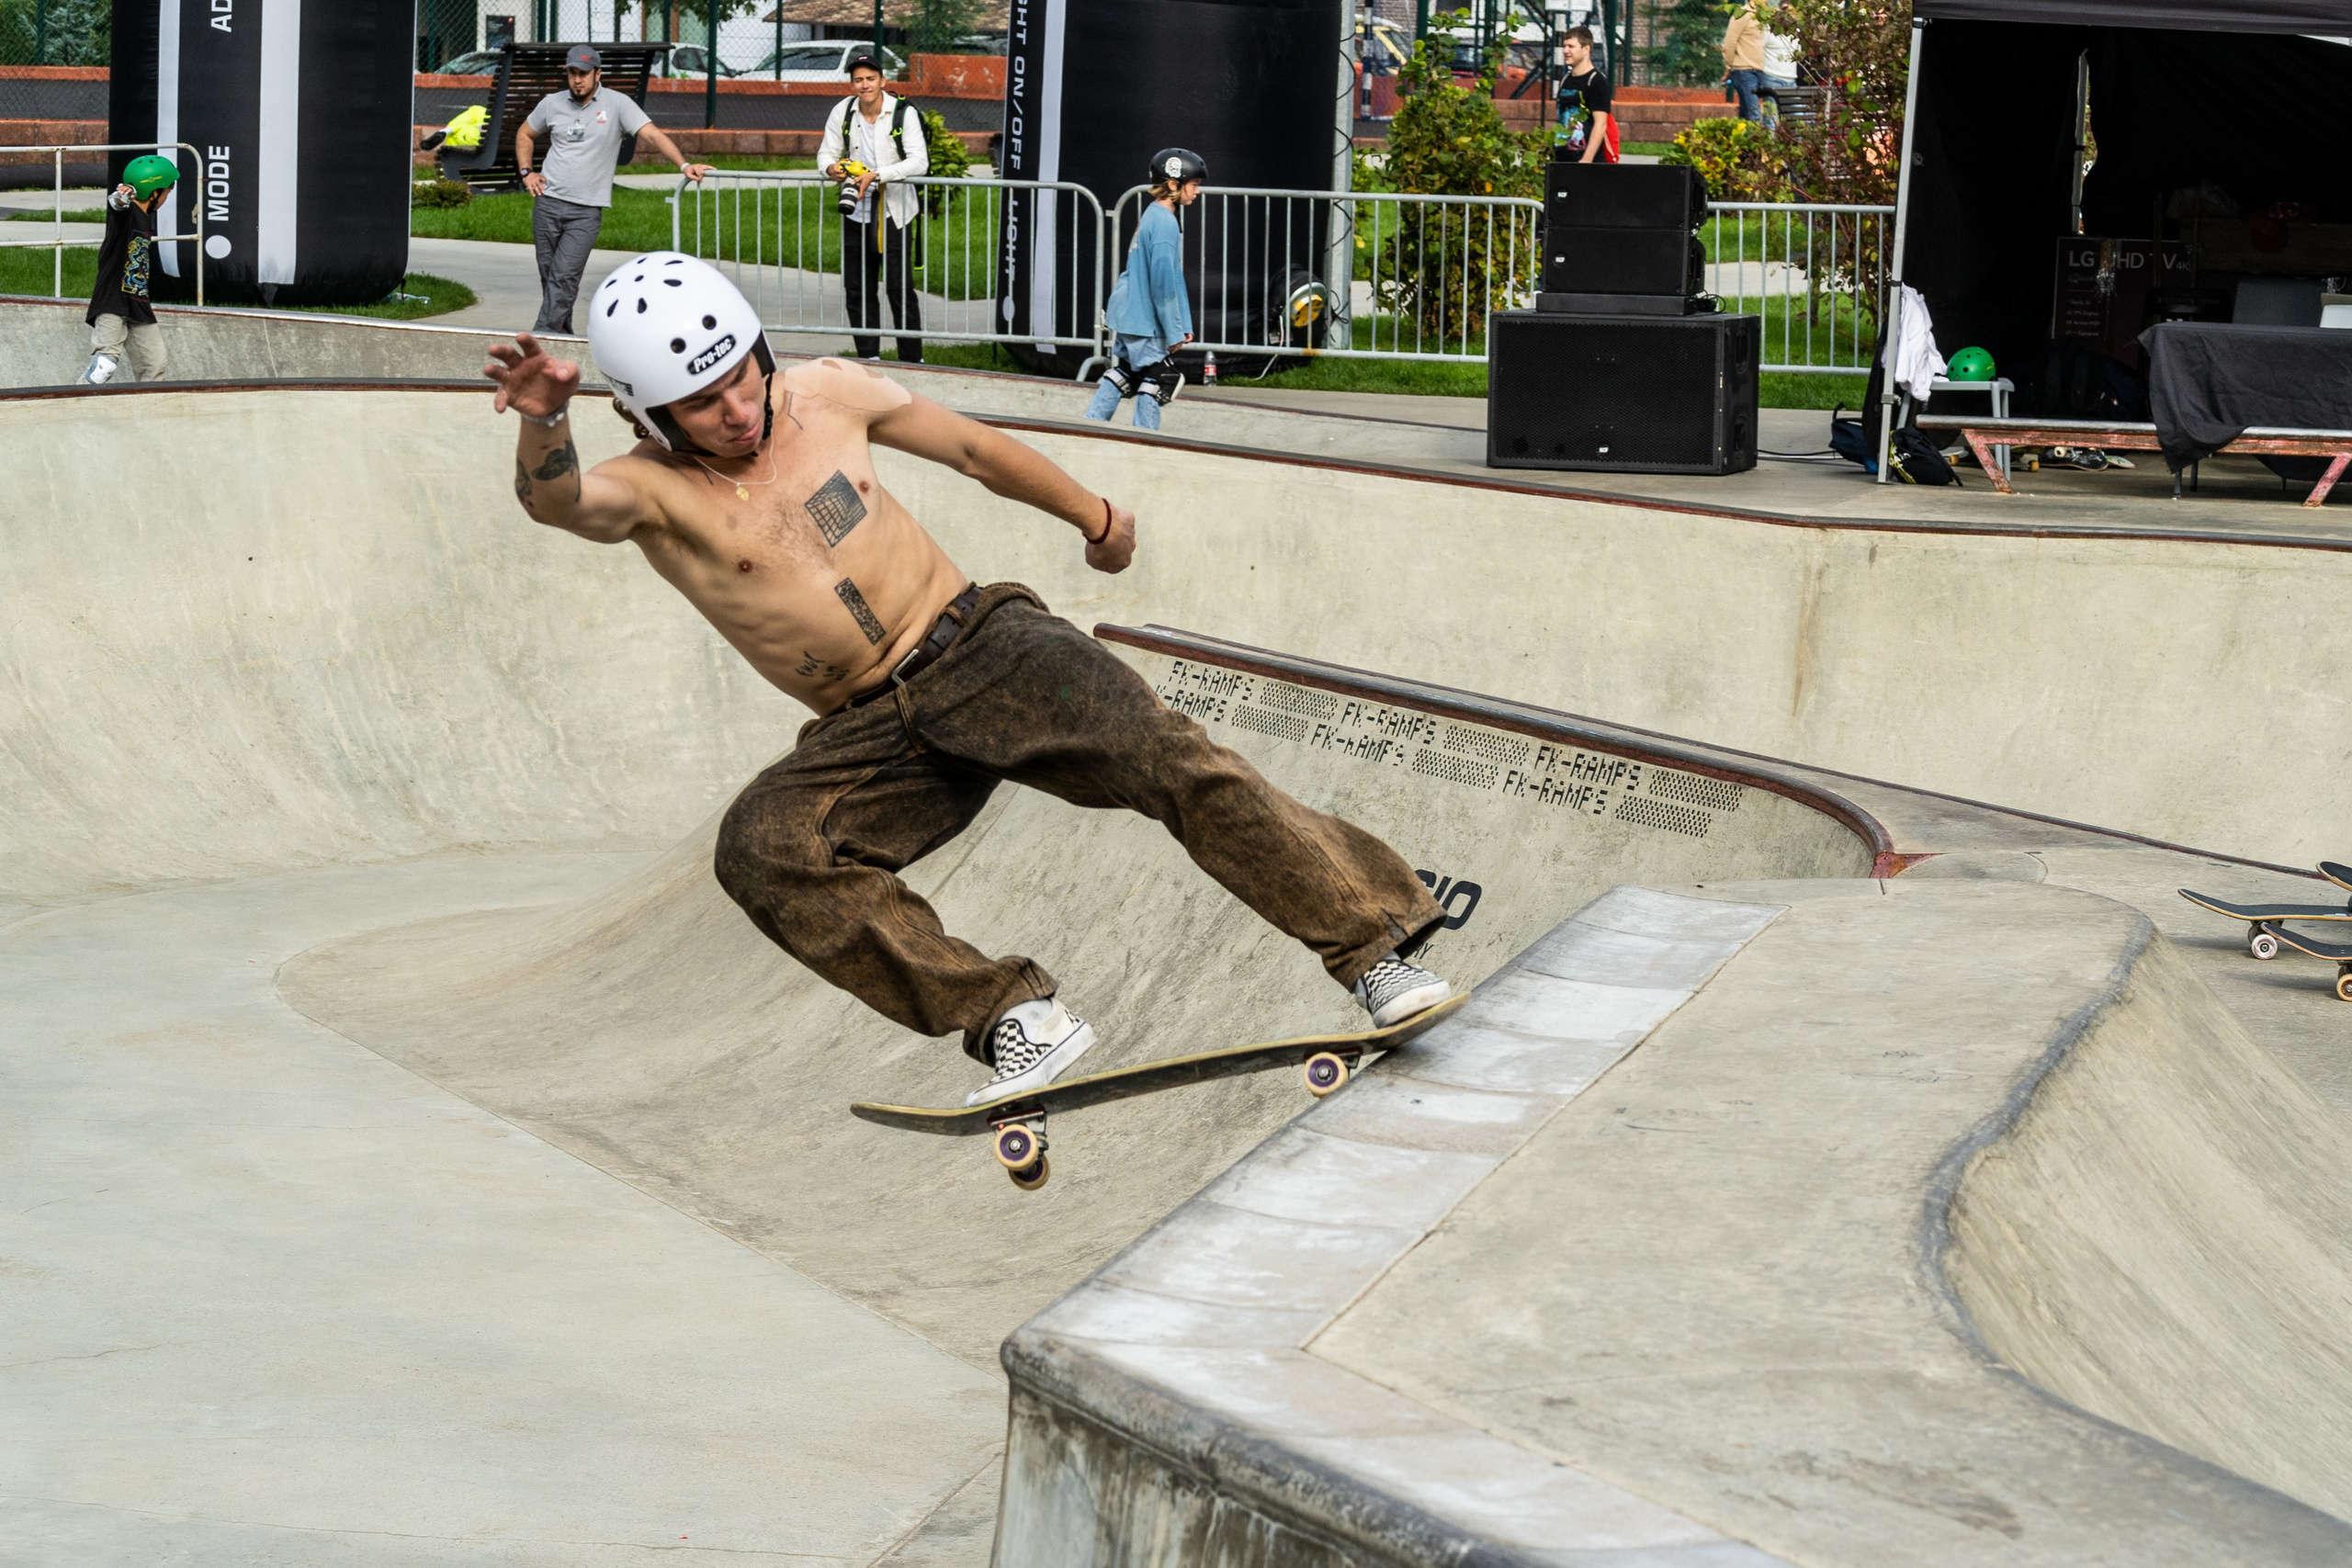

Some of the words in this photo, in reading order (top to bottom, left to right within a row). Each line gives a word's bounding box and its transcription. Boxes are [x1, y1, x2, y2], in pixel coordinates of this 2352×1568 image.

[210, 0, 232, 33] AD
[1015, 0, 1027, 45] HT
[1011, 56, 1025, 170] ON/OFF
[208, 145, 230, 221] MODE
[2069, 251, 2095, 267] LG
[693, 338, 732, 372] Pro-tec
[1169, 660, 1255, 701] FK-RAMPS
[1340, 701, 1437, 745] FK-RAMPS
[1533, 745, 1642, 791] FK-RAMPS
[1310, 723, 1404, 766] FK-RAMPS
[1502, 770, 1609, 815] FK-RAMPS
